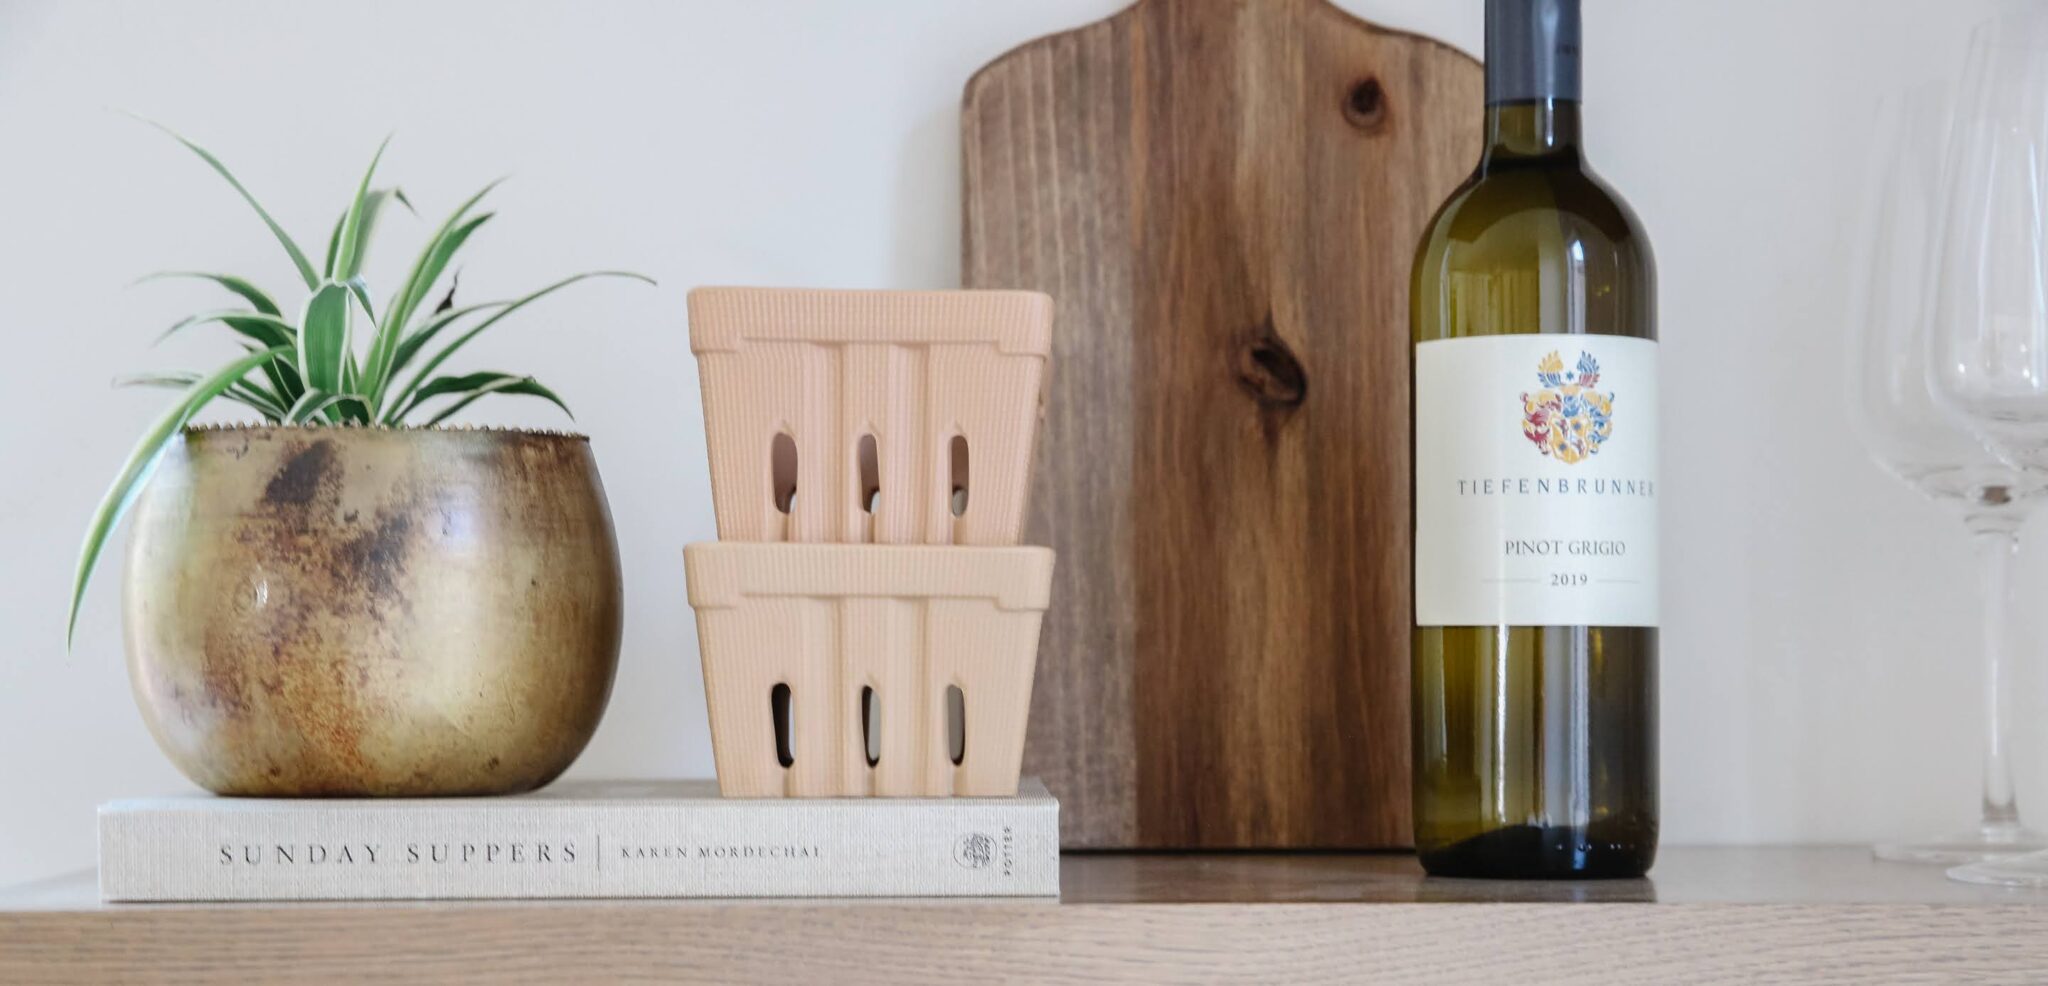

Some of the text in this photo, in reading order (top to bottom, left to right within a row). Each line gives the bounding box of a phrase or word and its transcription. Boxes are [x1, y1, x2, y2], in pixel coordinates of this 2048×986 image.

[1504, 540, 1626, 556] PINOT GRIGIO
[1551, 573, 1588, 586] 2019
[219, 843, 577, 866] SUNDAY SUPPERS
[621, 846, 822, 859] KAREN MORDECHAI
[1002, 825, 1013, 877] POTTER
